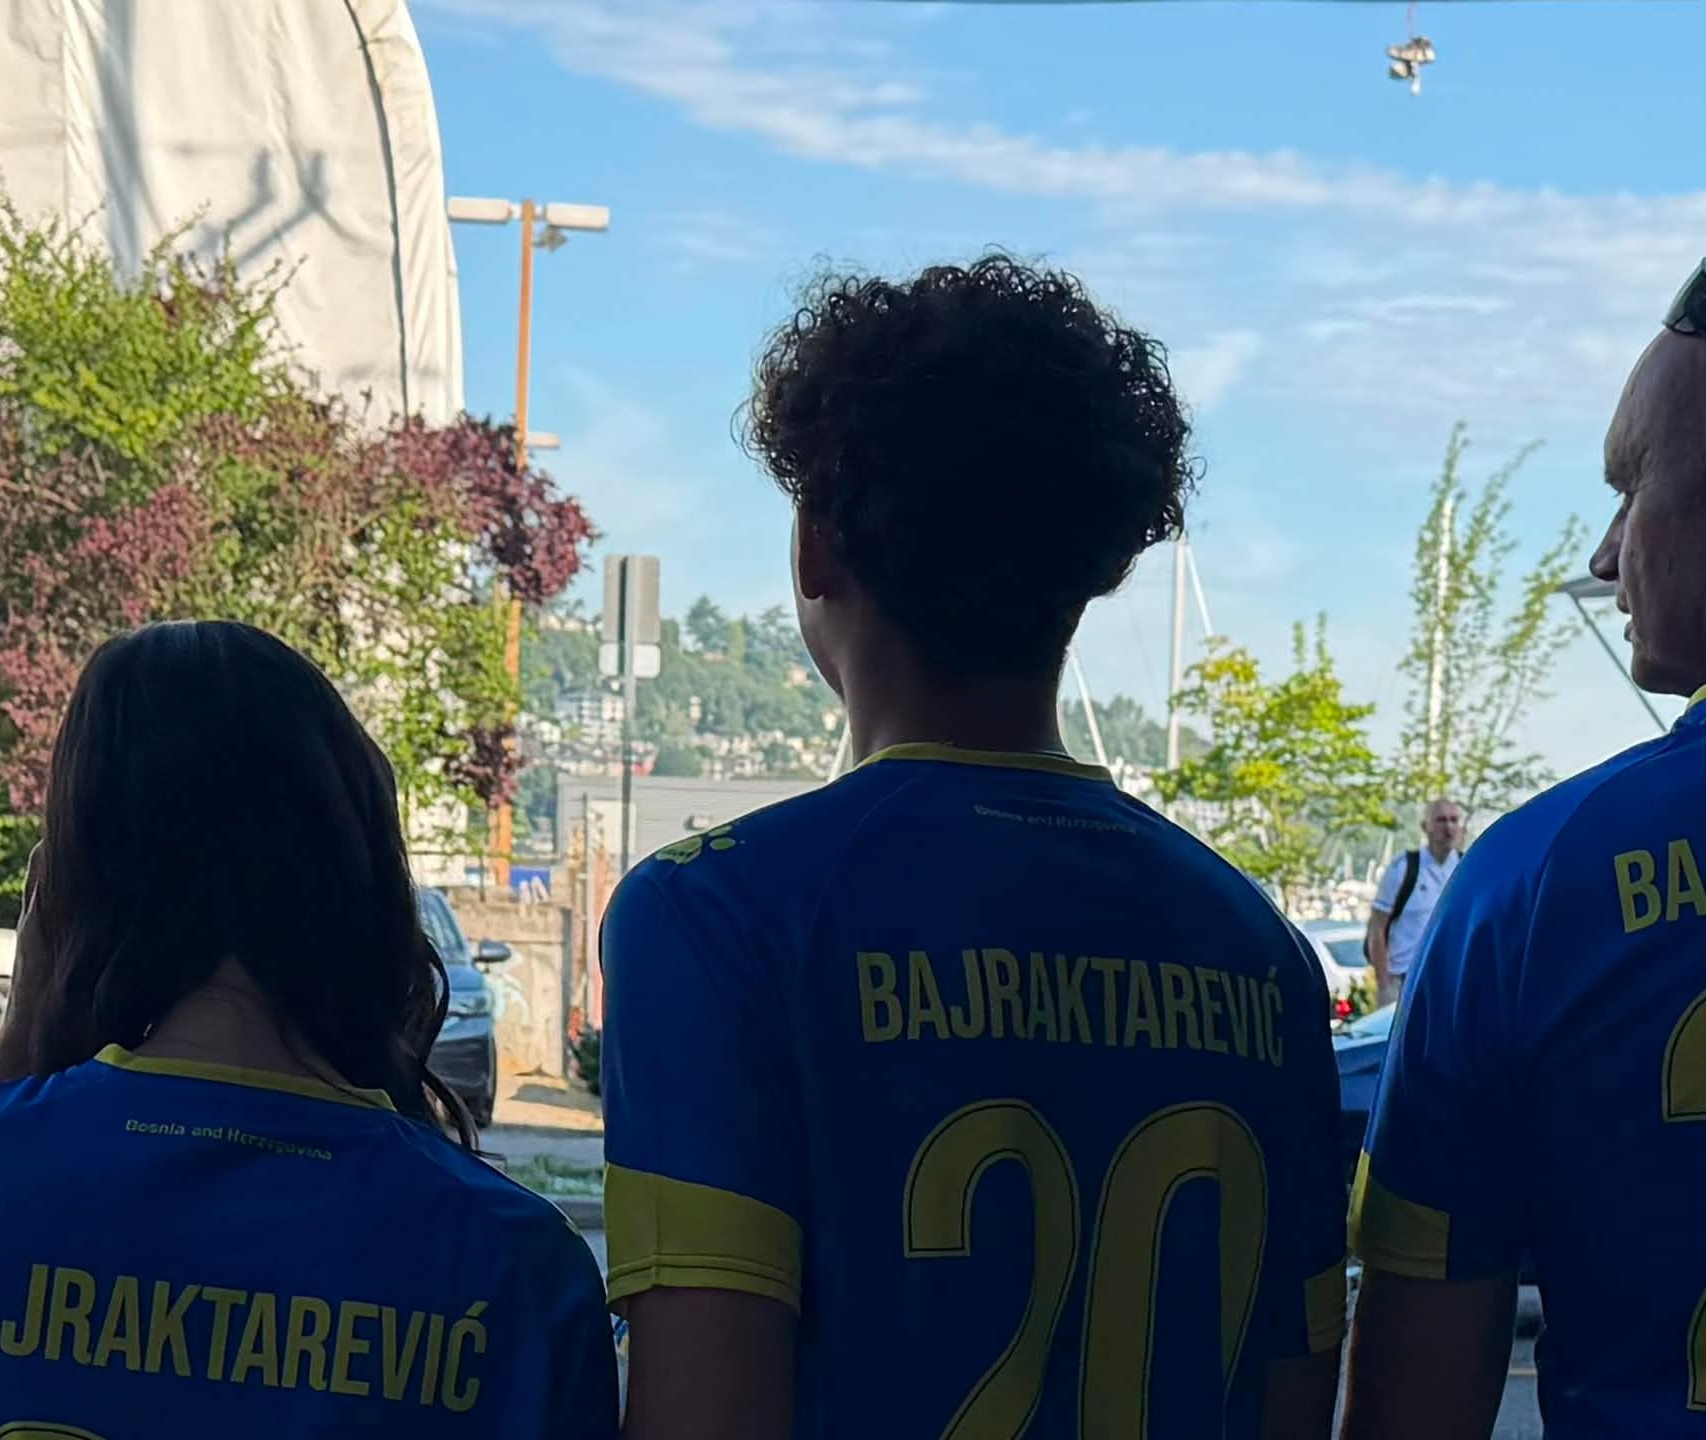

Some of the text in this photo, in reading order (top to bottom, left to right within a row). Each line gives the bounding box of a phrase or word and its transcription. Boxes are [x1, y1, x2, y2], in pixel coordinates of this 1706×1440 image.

[856, 947, 1283, 1068] BAJRAKTAREVIĆ
[125, 1118, 332, 1161] Bosnia and Herzegovina
